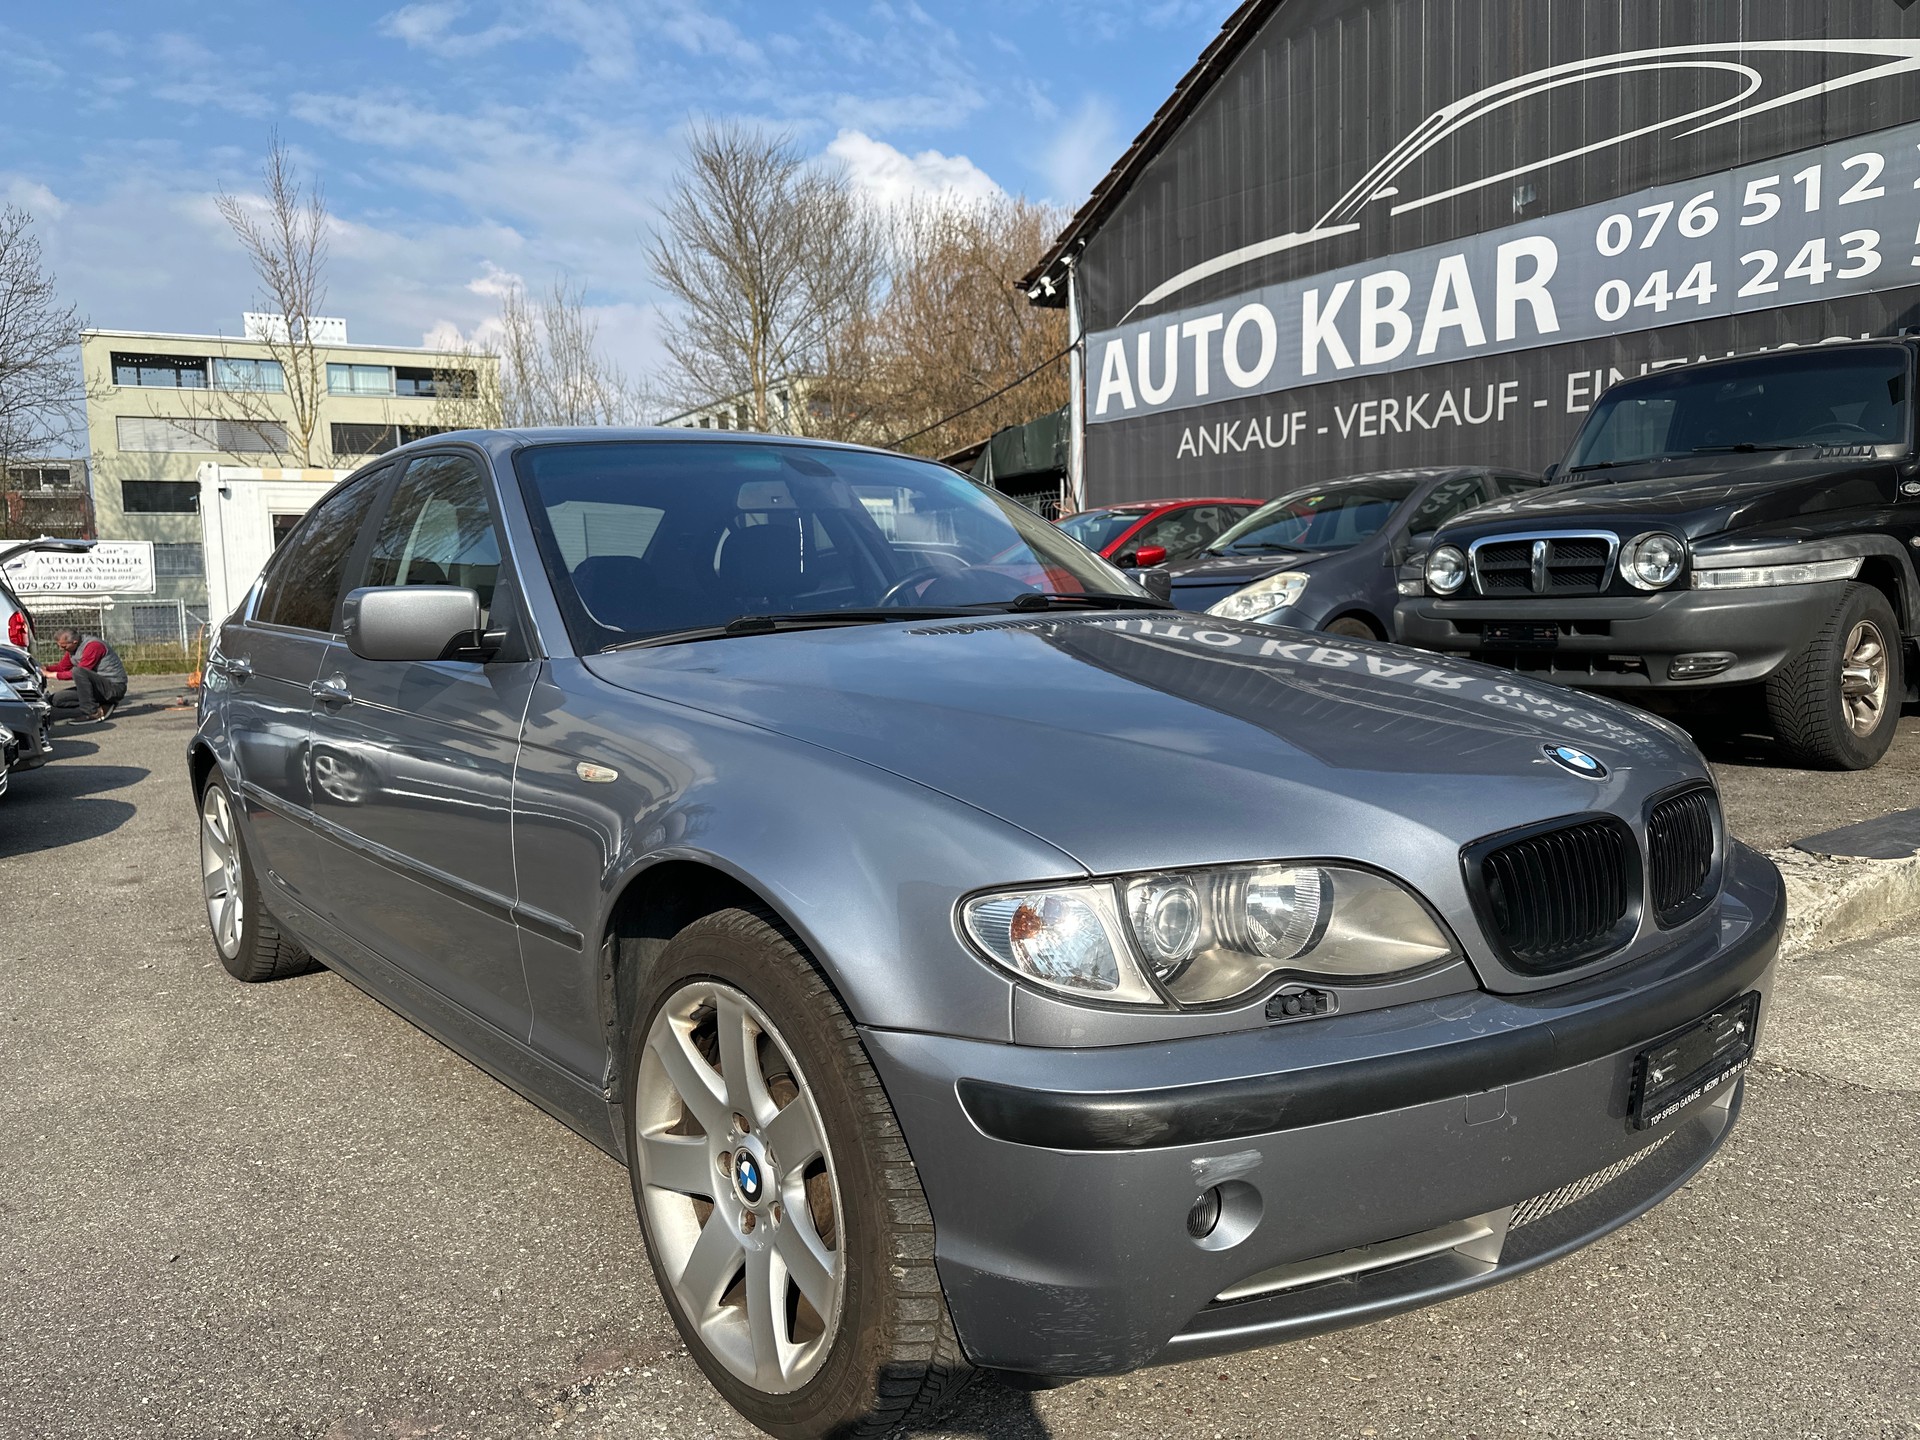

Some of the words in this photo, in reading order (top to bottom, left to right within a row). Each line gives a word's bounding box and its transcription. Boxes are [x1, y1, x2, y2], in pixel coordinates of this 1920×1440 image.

[1595, 190, 1719, 257] 076
[1739, 152, 1885, 226] 512
[1594, 261, 1717, 321] 044
[1737, 229, 1882, 298] 243
[1095, 303, 1277, 415] AUTO
[1302, 235, 1560, 376] KBAR
[1176, 411, 1306, 459] ANKAUF
[1334, 381, 1519, 439] VERKAUF
[18, 581, 38, 590] 079
[43, 581, 61, 590] 627
[67, 581, 78, 590] 19
[82, 581, 97, 590] 00
[38, 556, 142, 565] AUTOHÄNDLER
[1650, 1113, 1662, 1126] TOP
[1662, 1102, 1679, 1120] SPEED
[1680, 1088, 1701, 1108] GARAGE
